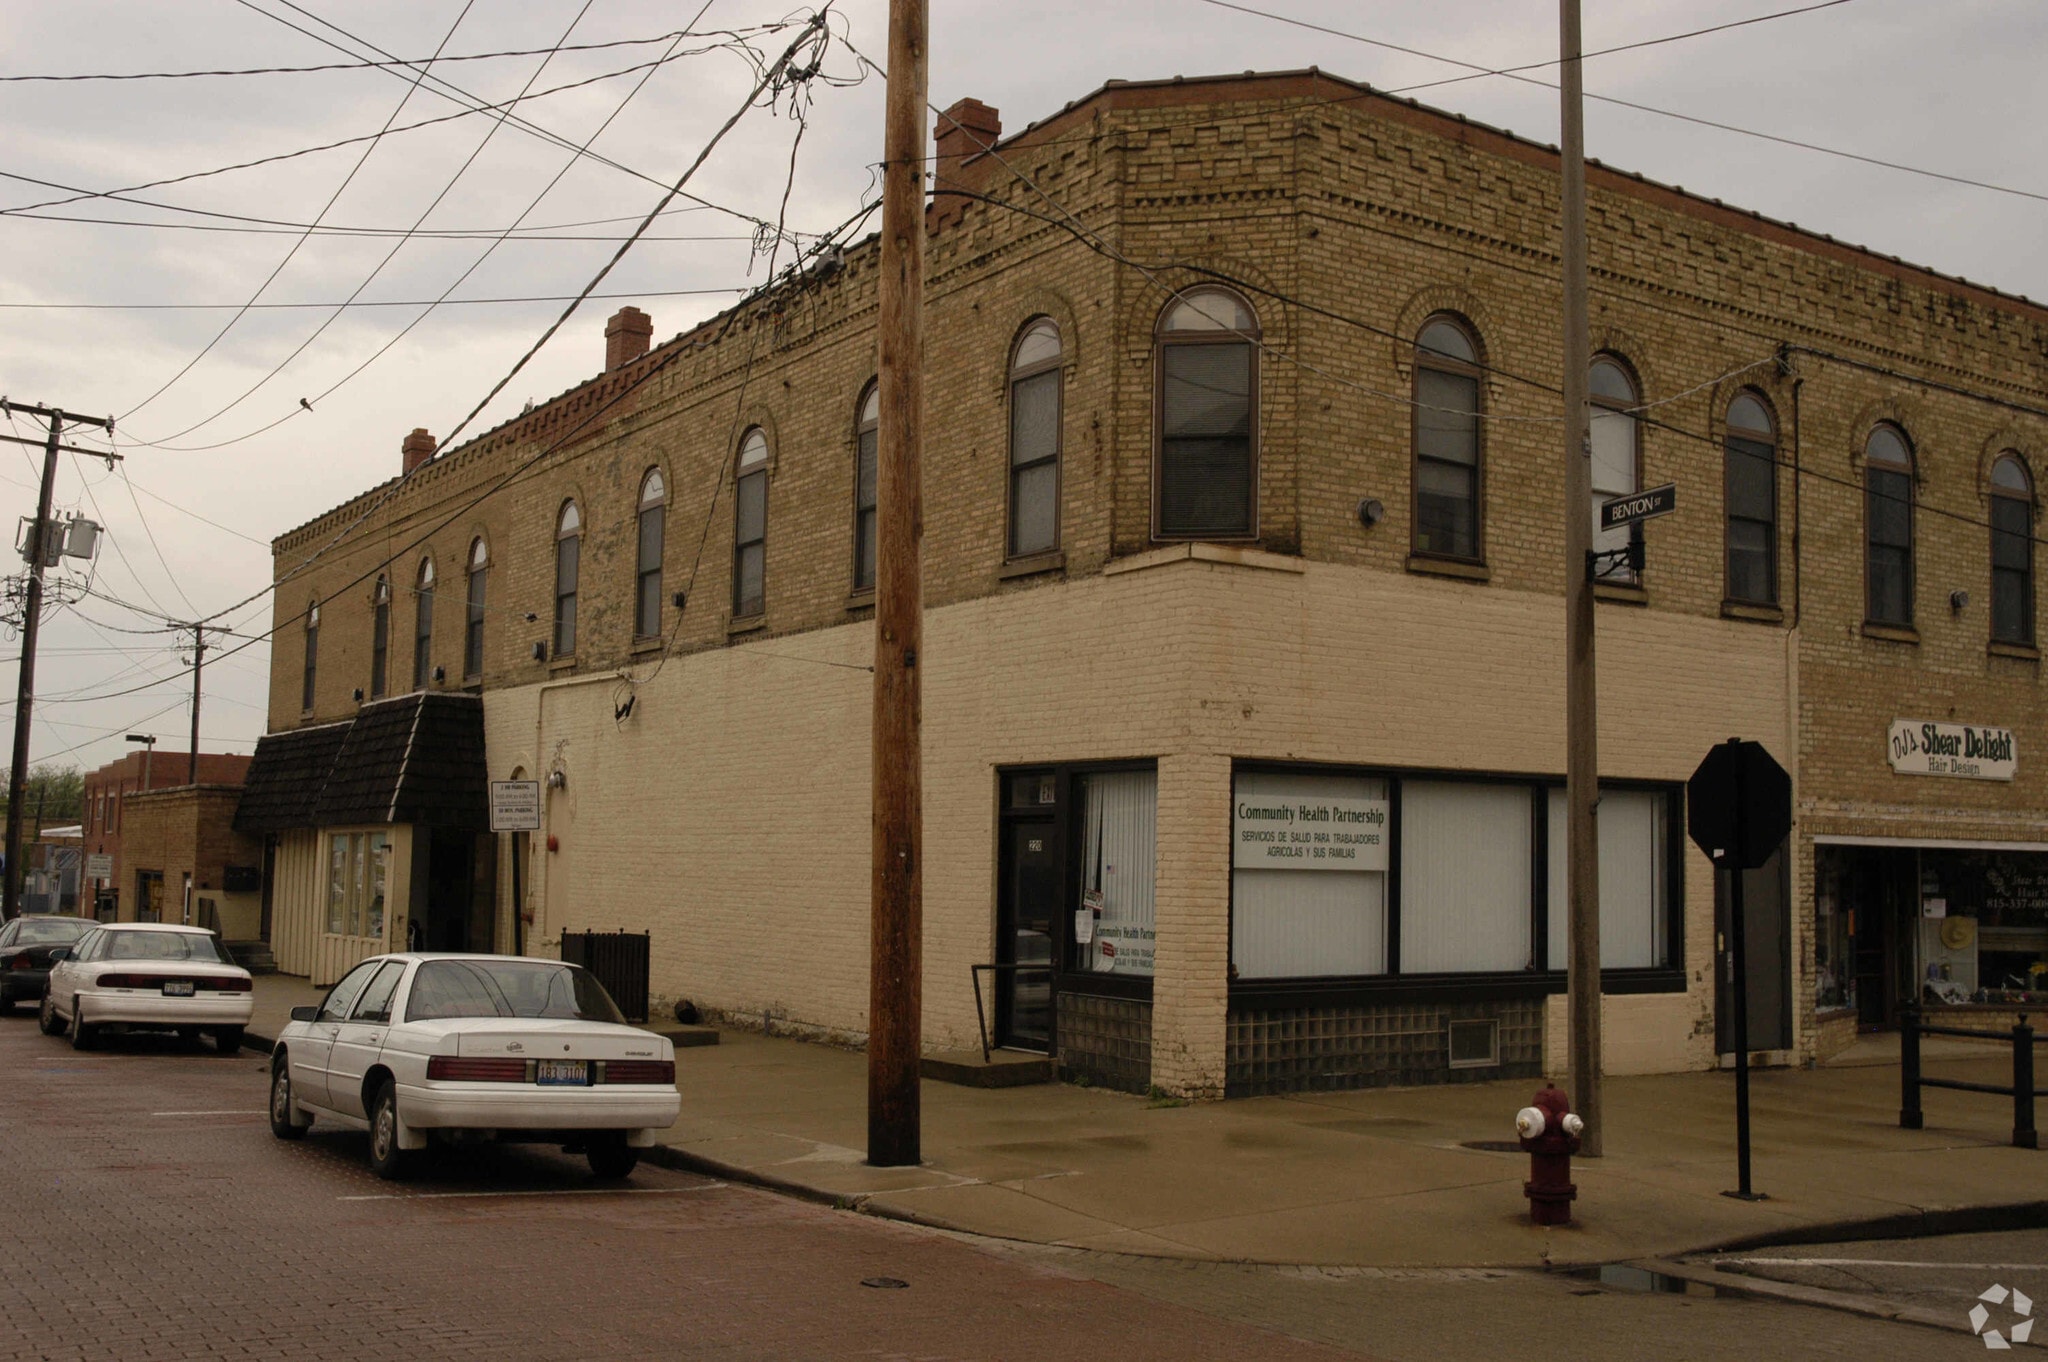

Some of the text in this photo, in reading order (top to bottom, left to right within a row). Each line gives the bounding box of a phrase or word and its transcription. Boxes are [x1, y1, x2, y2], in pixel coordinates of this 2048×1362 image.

[1612, 496, 1653, 520] BENTON
[1921, 723, 1961, 757] Shear
[1964, 727, 2012, 762] Delight
[1928, 757, 1980, 776] Hair Design
[1238, 803, 1384, 828] Community Health Partnership
[1241, 830, 1380, 845] SERVICIOS DE SALUD PARA TRABAJADORES
[1267, 846, 1355, 859] AGRICOLAS Y SUS FAMILIAS
